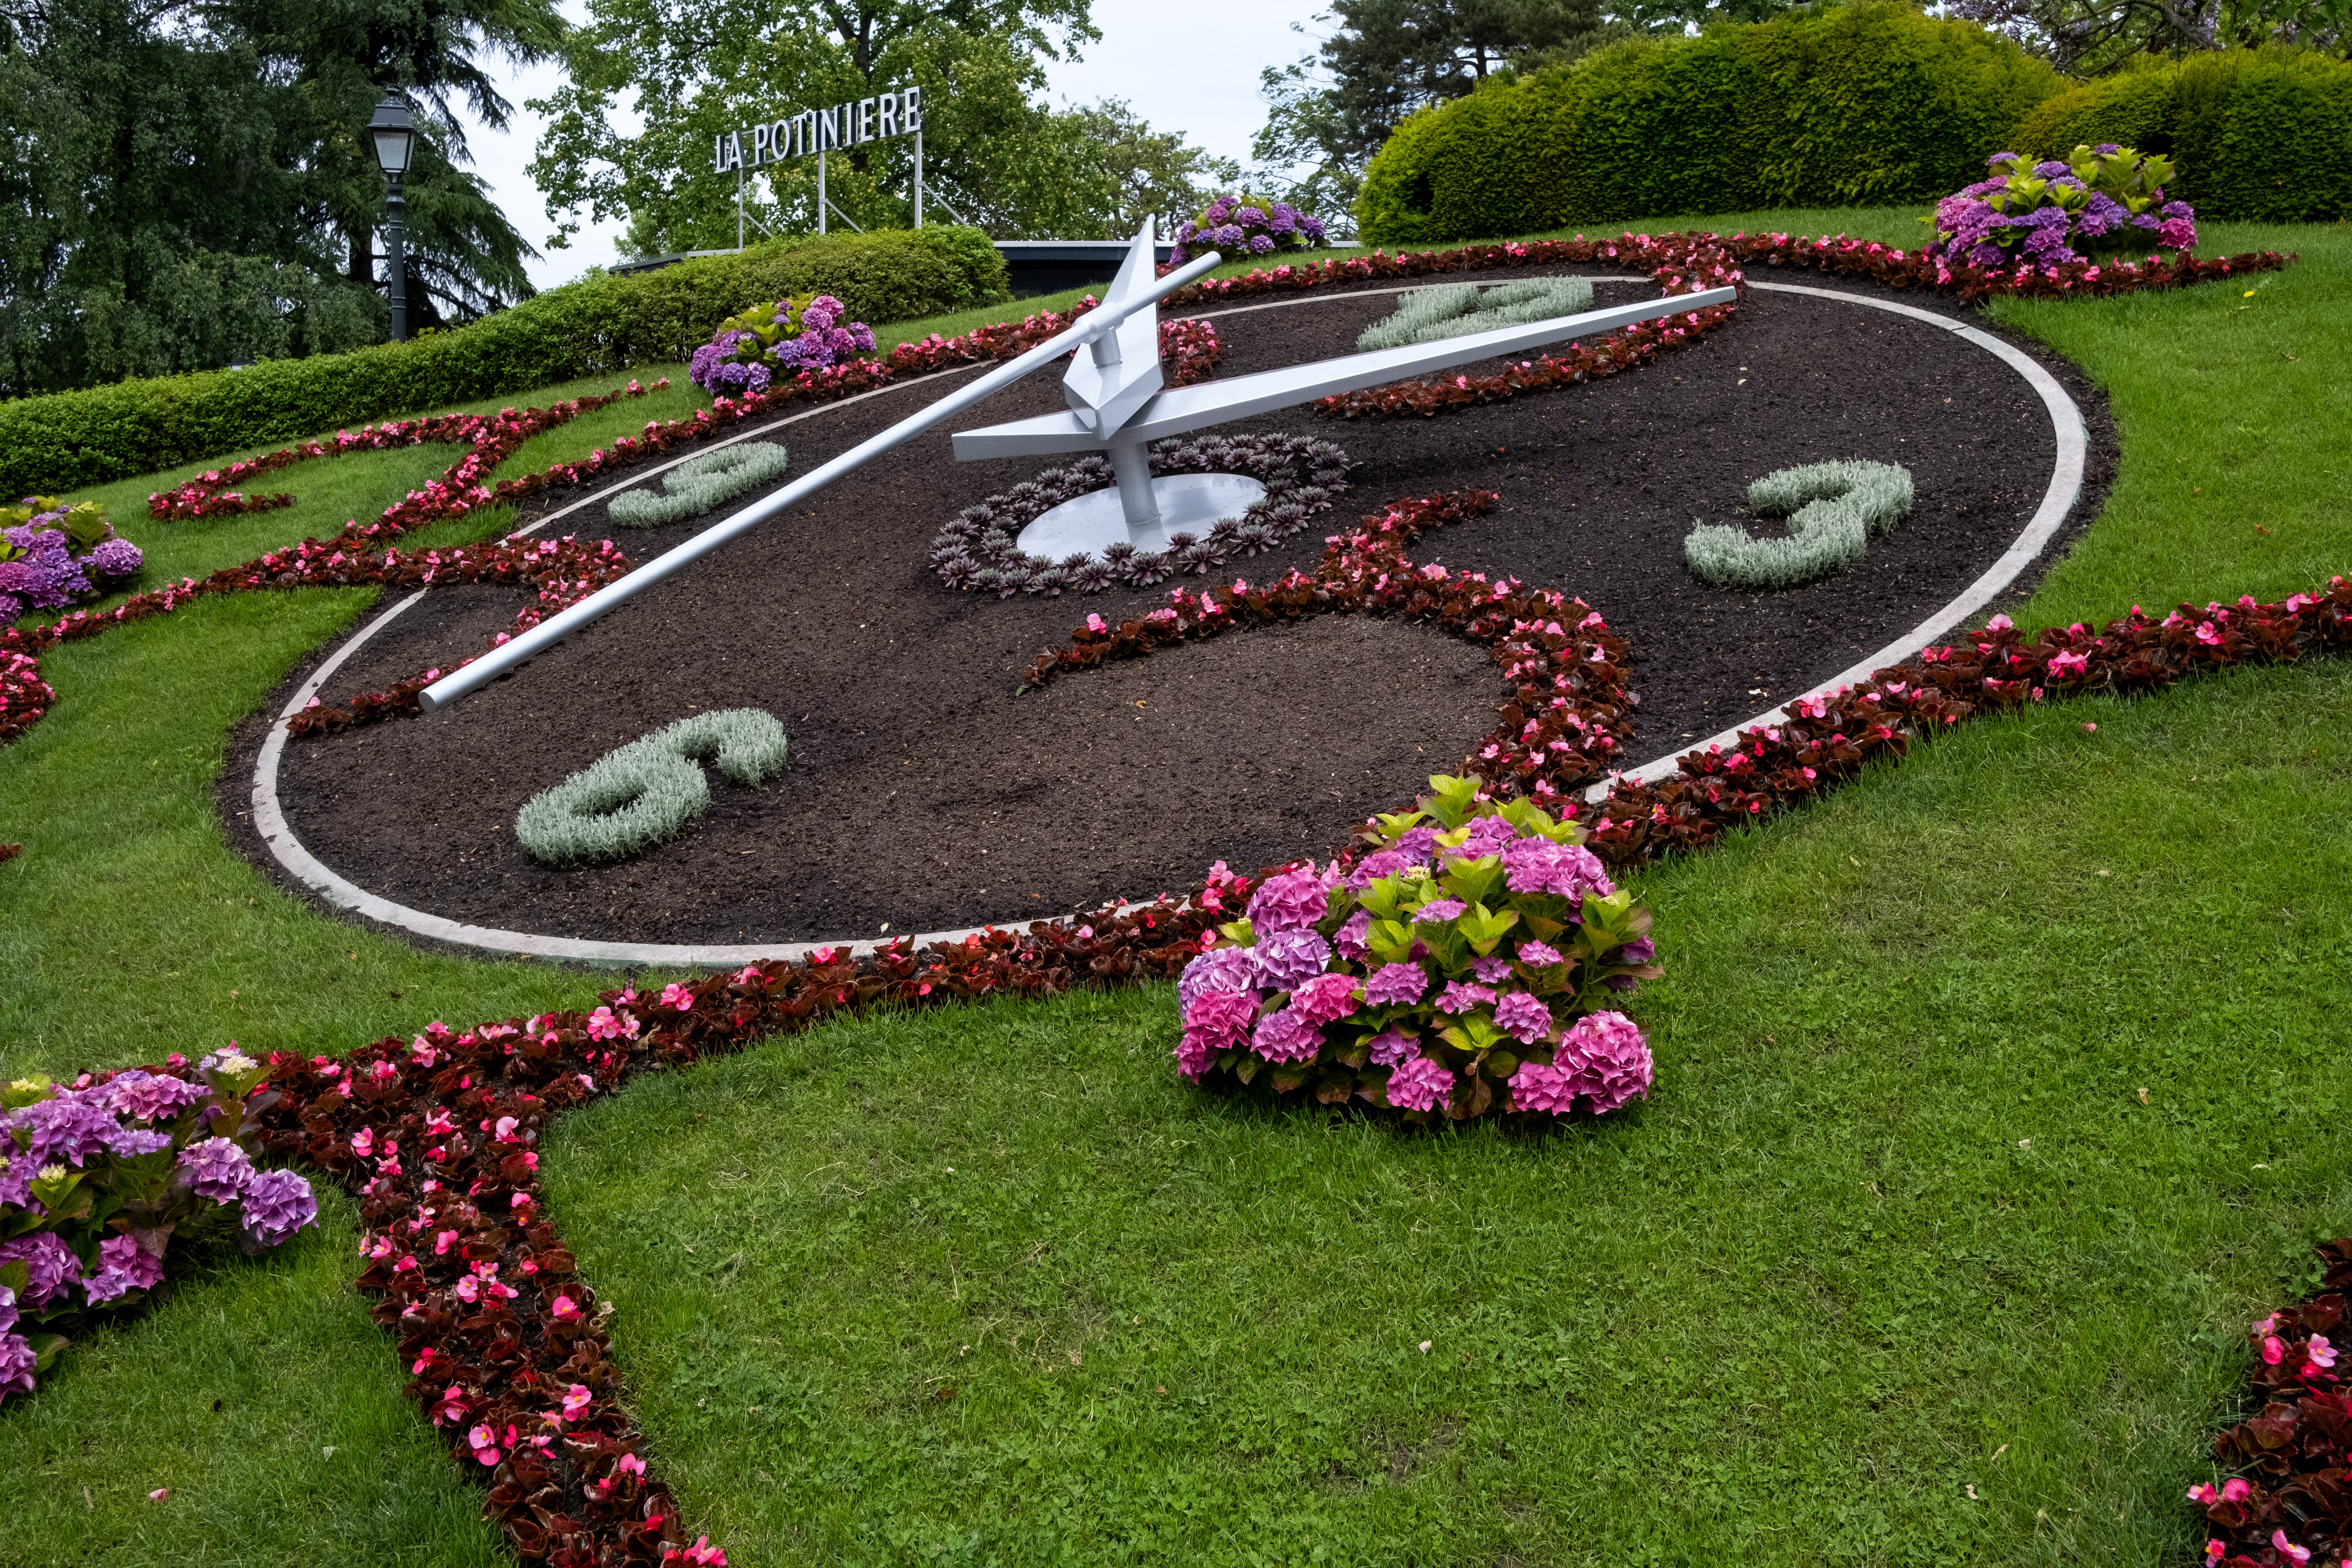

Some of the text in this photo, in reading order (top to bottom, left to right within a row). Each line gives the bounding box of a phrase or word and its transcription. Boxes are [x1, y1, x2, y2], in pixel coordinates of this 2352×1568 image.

[715, 86, 922, 173] LA POTINIERE
[607, 441, 787, 529] 9
[1684, 457, 1915, 589] 3
[514, 707, 787, 863] 6
